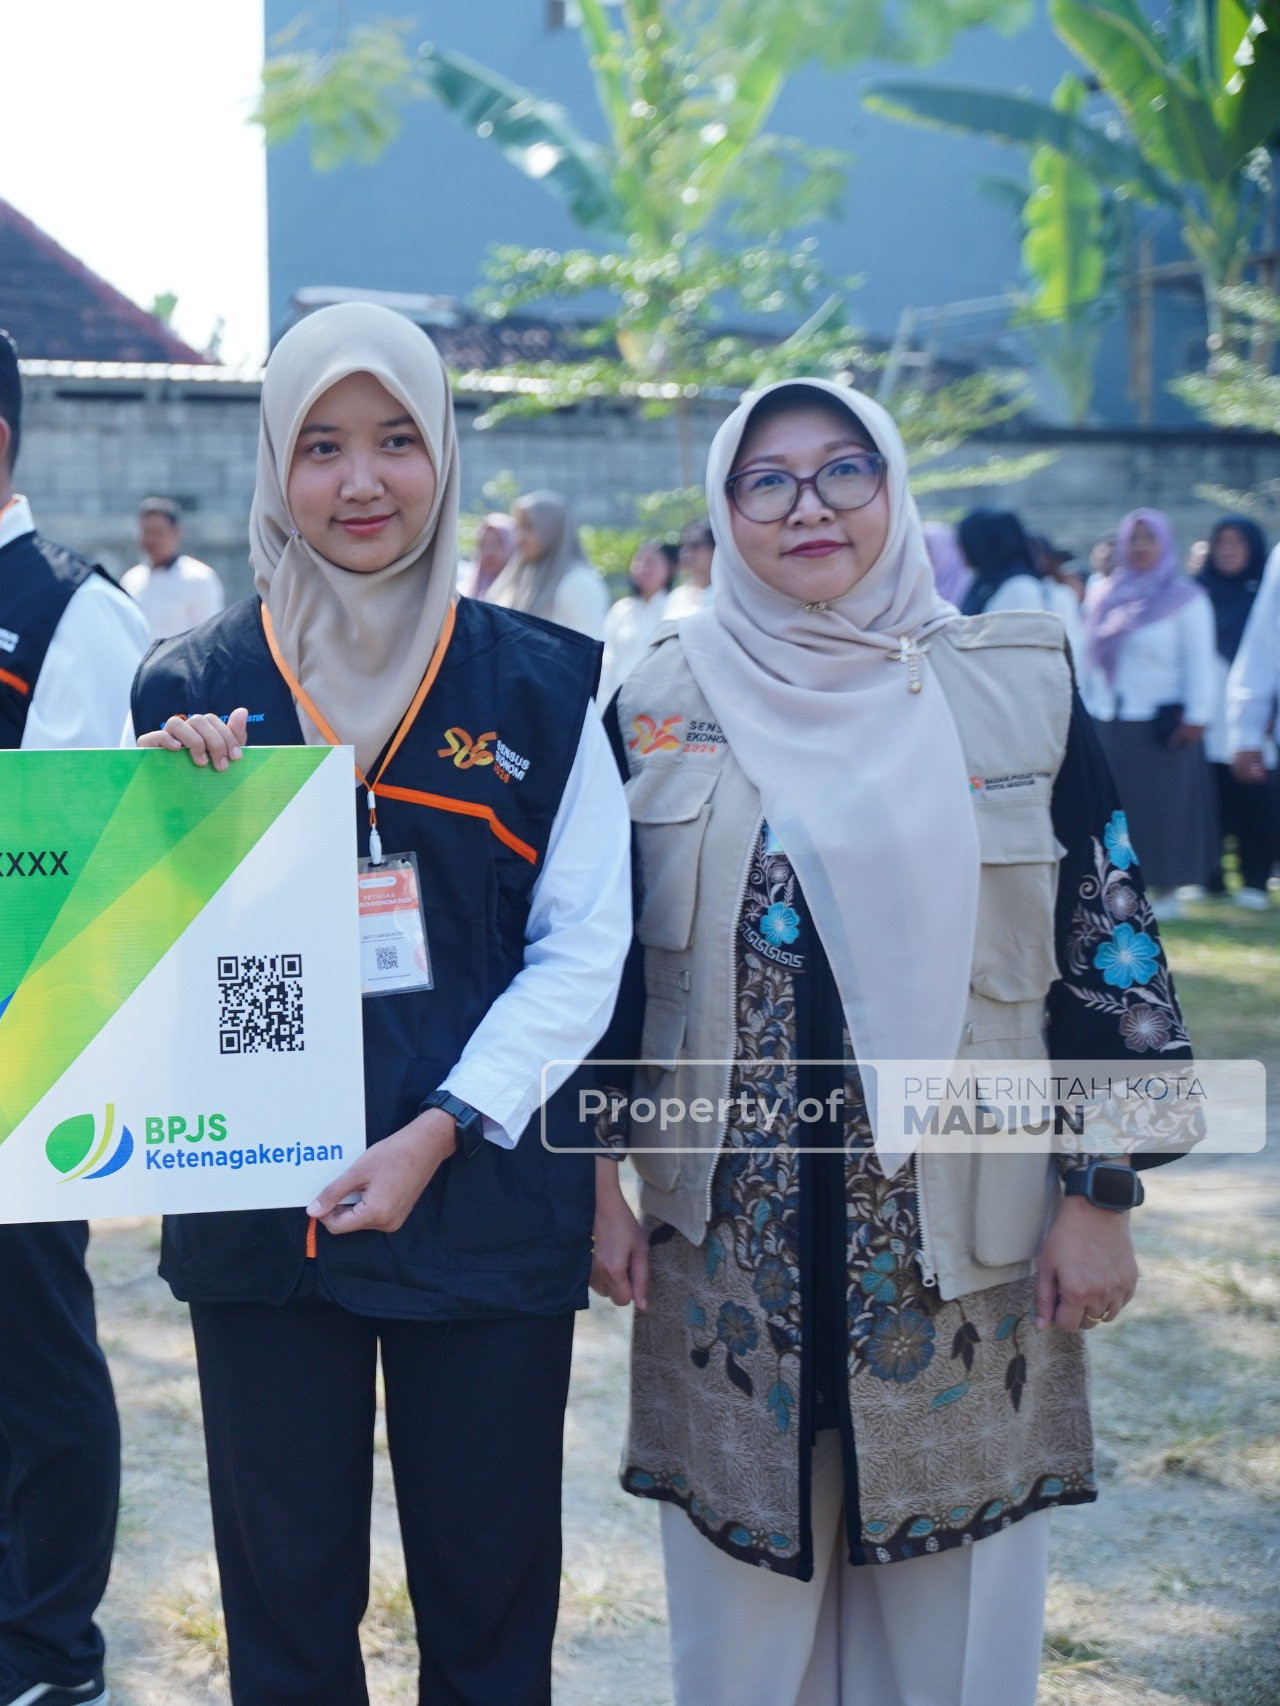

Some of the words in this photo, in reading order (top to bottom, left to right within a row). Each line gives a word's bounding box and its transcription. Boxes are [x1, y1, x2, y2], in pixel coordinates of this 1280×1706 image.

[689, 720, 723, 734] SENS
[685, 731, 728, 745] EKONO
[496, 739, 531, 771] SENSUS
[682, 743, 718, 753] 2026
[363, 893, 396, 901] PETUGAS
[145, 1113, 228, 1145] BPJS
[145, 1143, 344, 1170] Ketenagakerjaan
